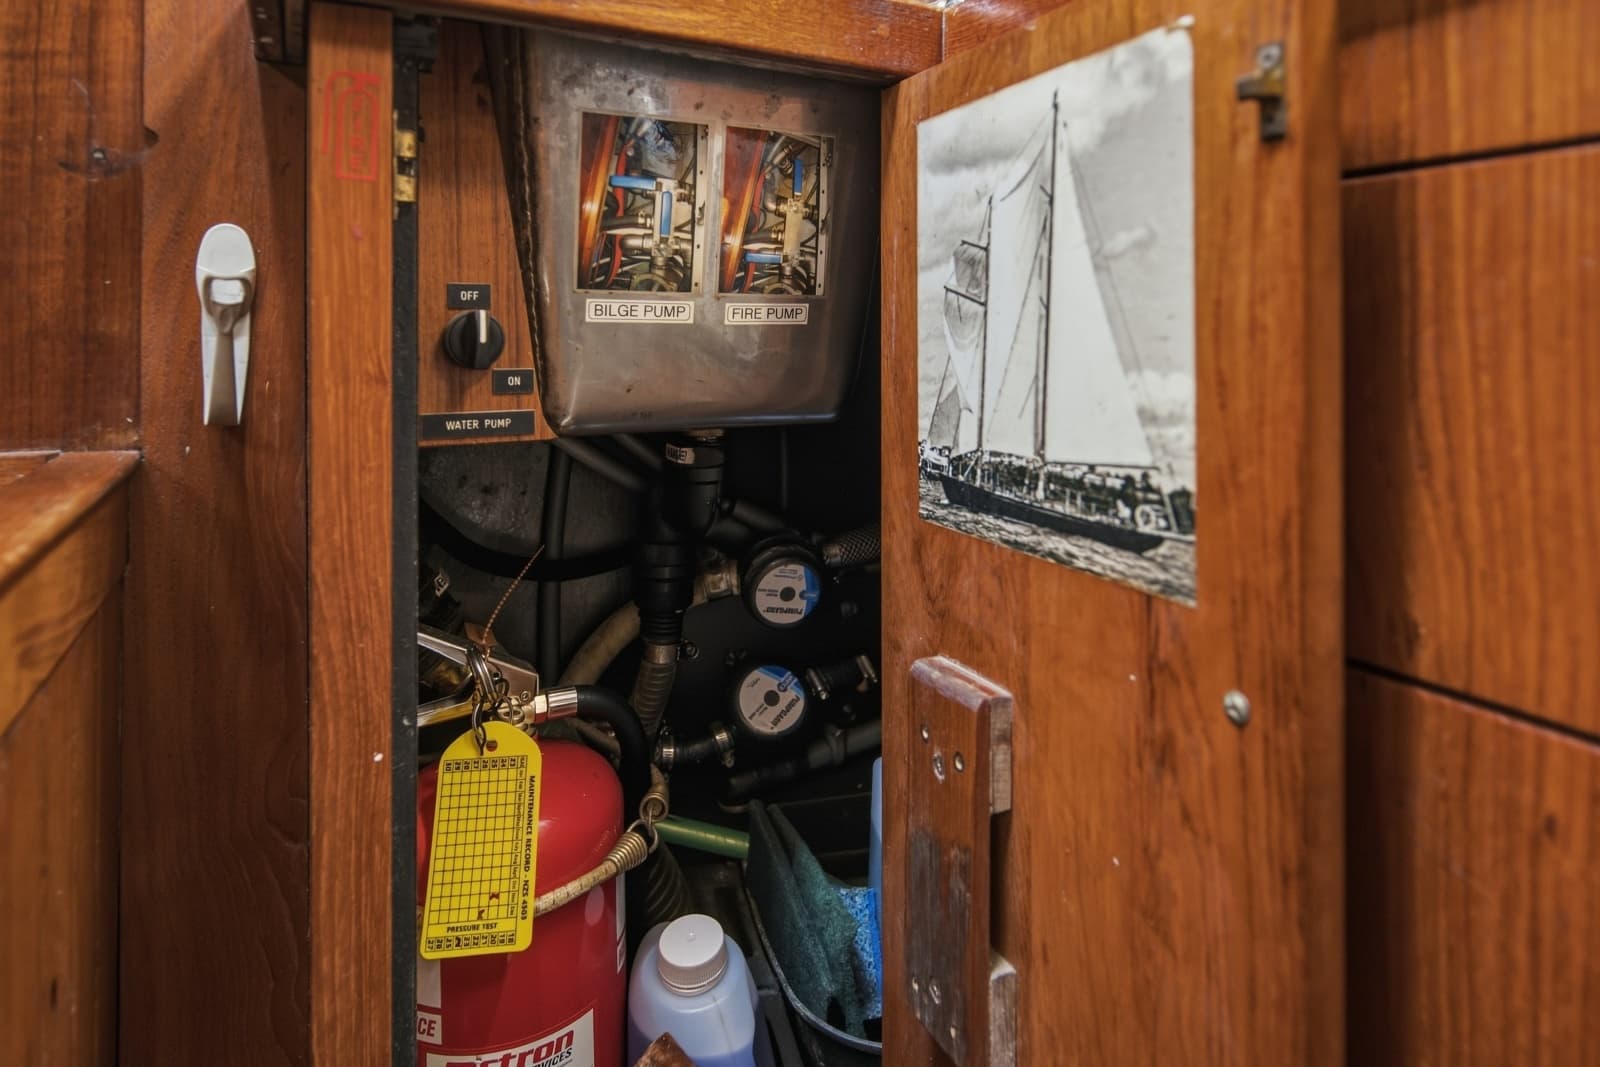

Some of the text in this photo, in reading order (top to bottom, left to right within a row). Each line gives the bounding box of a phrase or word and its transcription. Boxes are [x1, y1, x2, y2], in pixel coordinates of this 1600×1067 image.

[460, 290, 479, 301] OFF
[594, 304, 686, 318] BILGE PUMP
[731, 307, 803, 320] FIRE PUMP
[507, 376, 521, 386] ON
[445, 418, 512, 431] WATER PUMP
[526, 775, 536, 835] MAINTENANCE
[524, 838, 532, 872] RECORD
[446, 924, 480, 933] PRESSURE
[416, 1016, 437, 1037] CE
